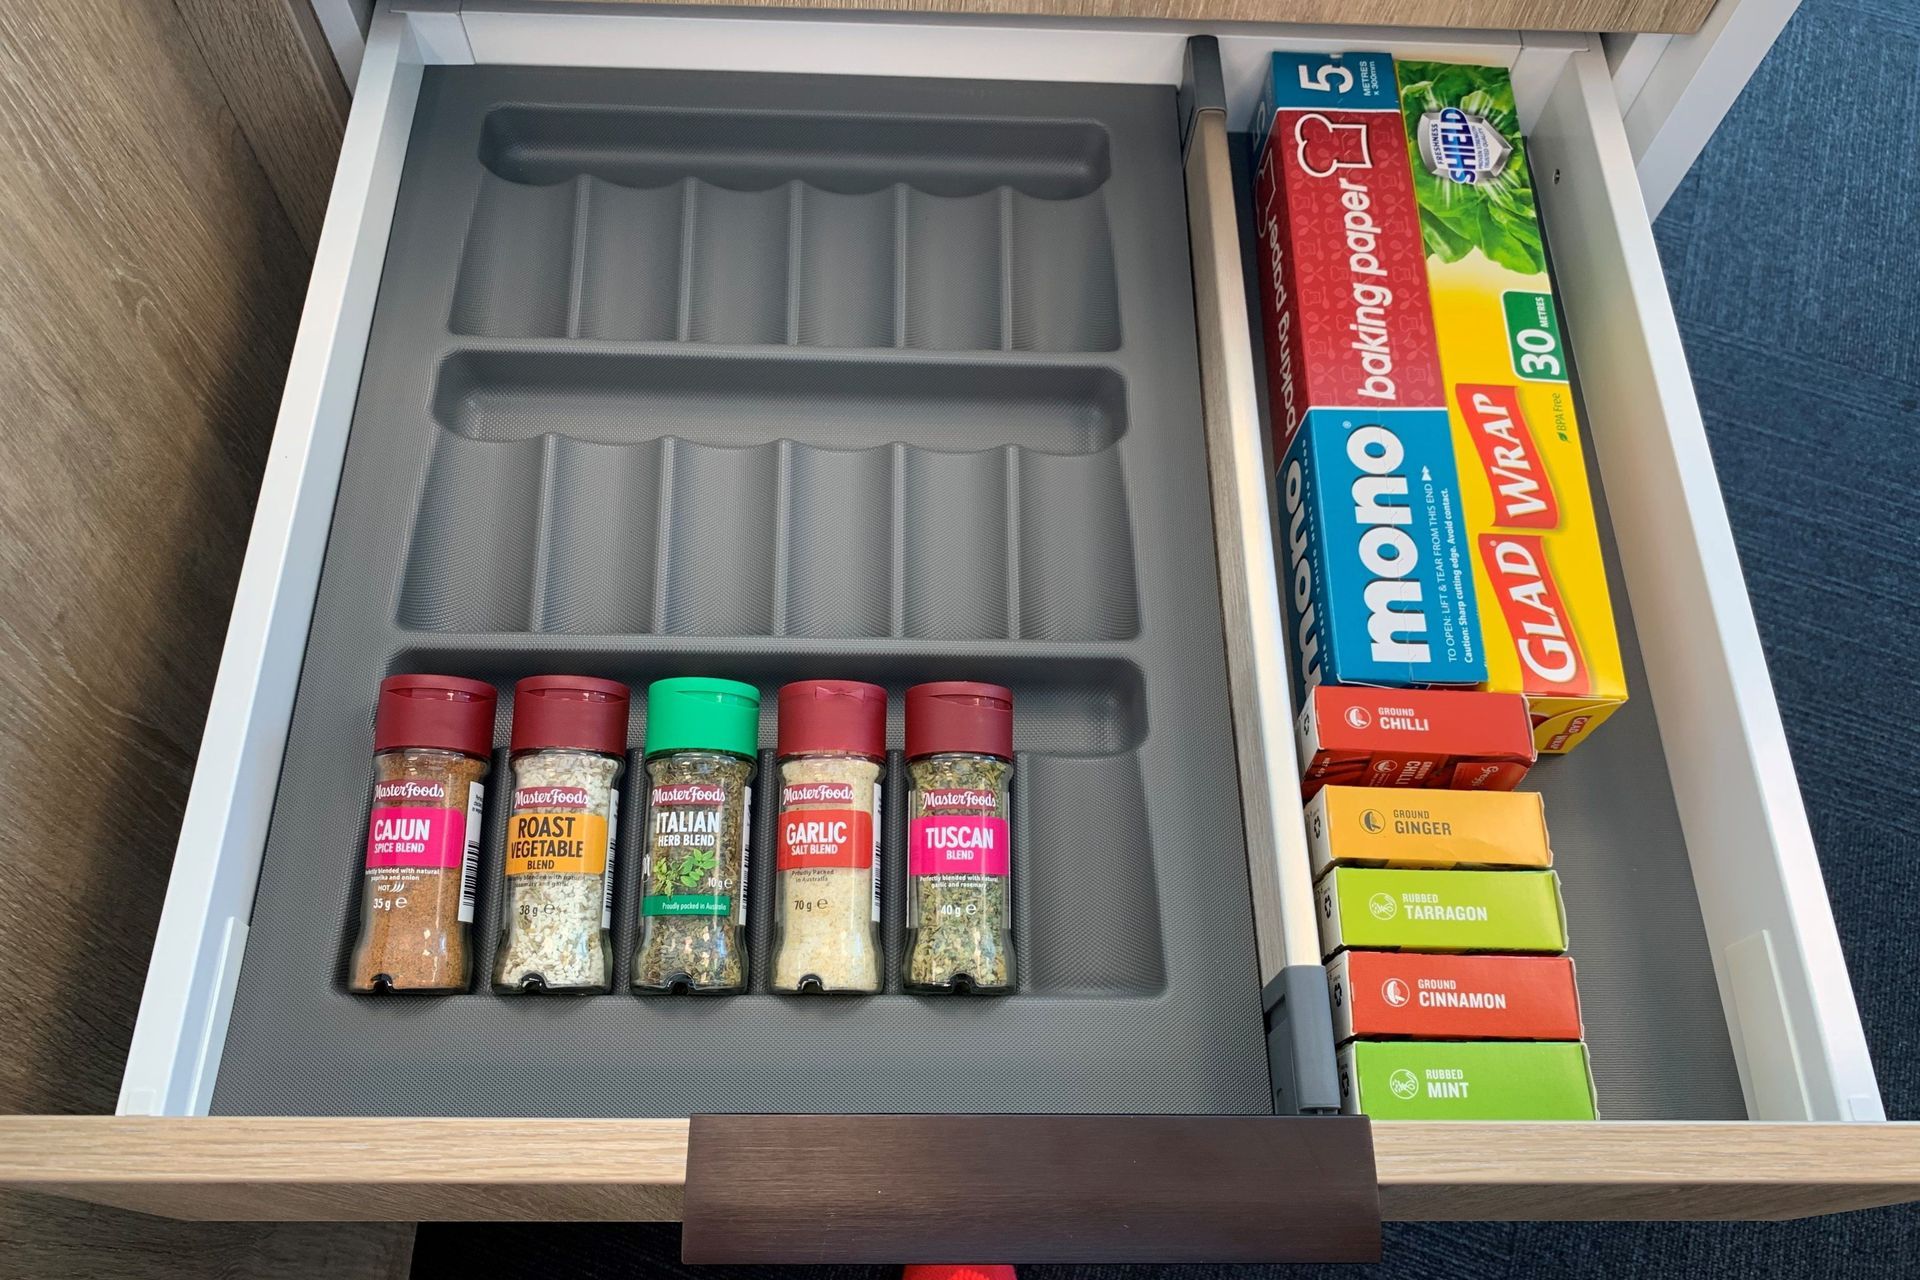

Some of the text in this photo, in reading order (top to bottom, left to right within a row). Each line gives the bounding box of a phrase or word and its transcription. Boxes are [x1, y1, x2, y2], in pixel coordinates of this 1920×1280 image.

[1298, 63, 1353, 94] 5
[1359, 61, 1371, 96] METRES
[1431, 123, 1444, 165] FRESHNESS
[1440, 108, 1476, 184] SHIELD
[1339, 177, 1396, 401] baking paper
[1269, 214, 1296, 437] baking paper
[1516, 296, 1561, 375] 30 METRES
[1552, 392, 1567, 431] BPA Free
[1346, 425, 1431, 663] mono
[1472, 393, 1577, 683] GLAD WRAP
[1424, 483, 1458, 663] TO OPEN: LIFT & TEAR FROM THIS END
[1441, 487, 1473, 664] Caution: Sharp cutting edge. Avoid contact.
[1378, 707, 1415, 716] GROUND
[1380, 717, 1430, 731] CHILLI
[374, 782, 445, 802] MasterFoods
[514, 788, 589, 809] MasterFoods
[651, 786, 726, 806] MasterFoods
[782, 784, 854, 805] MasterFoods
[923, 791, 996, 810] MasterFoods
[656, 811, 720, 833] ITALIAN
[1393, 809, 1430, 819] GROUND
[374, 818, 430, 841] CAJUN
[518, 816, 576, 839] ROAST
[786, 821, 847, 845] GARLIC
[1395, 820, 1452, 836] GINGER
[658, 834, 715, 847] HERB BLEND
[925, 826, 994, 849] TUSCAN
[374, 842, 425, 854] SPICE BLEND
[511, 840, 584, 859] VEGETABLE
[791, 844, 838, 856] SALT BLEND
[946, 850, 974, 860] BLEND
[527, 860, 555, 870] BLEND
[373, 898, 383, 909] 35
[794, 899, 804, 910] 70
[1402, 893, 1438, 903] RUBBED
[519, 904, 530, 915] 38
[941, 904, 953, 915] 40
[1404, 905, 1488, 921] TARRAGON
[1417, 978, 1456, 990] GROUND
[1418, 991, 1507, 1009] CINNAMON
[1425, 1069, 1463, 1080] RUBBED
[1427, 1082, 1469, 1098] MINT
